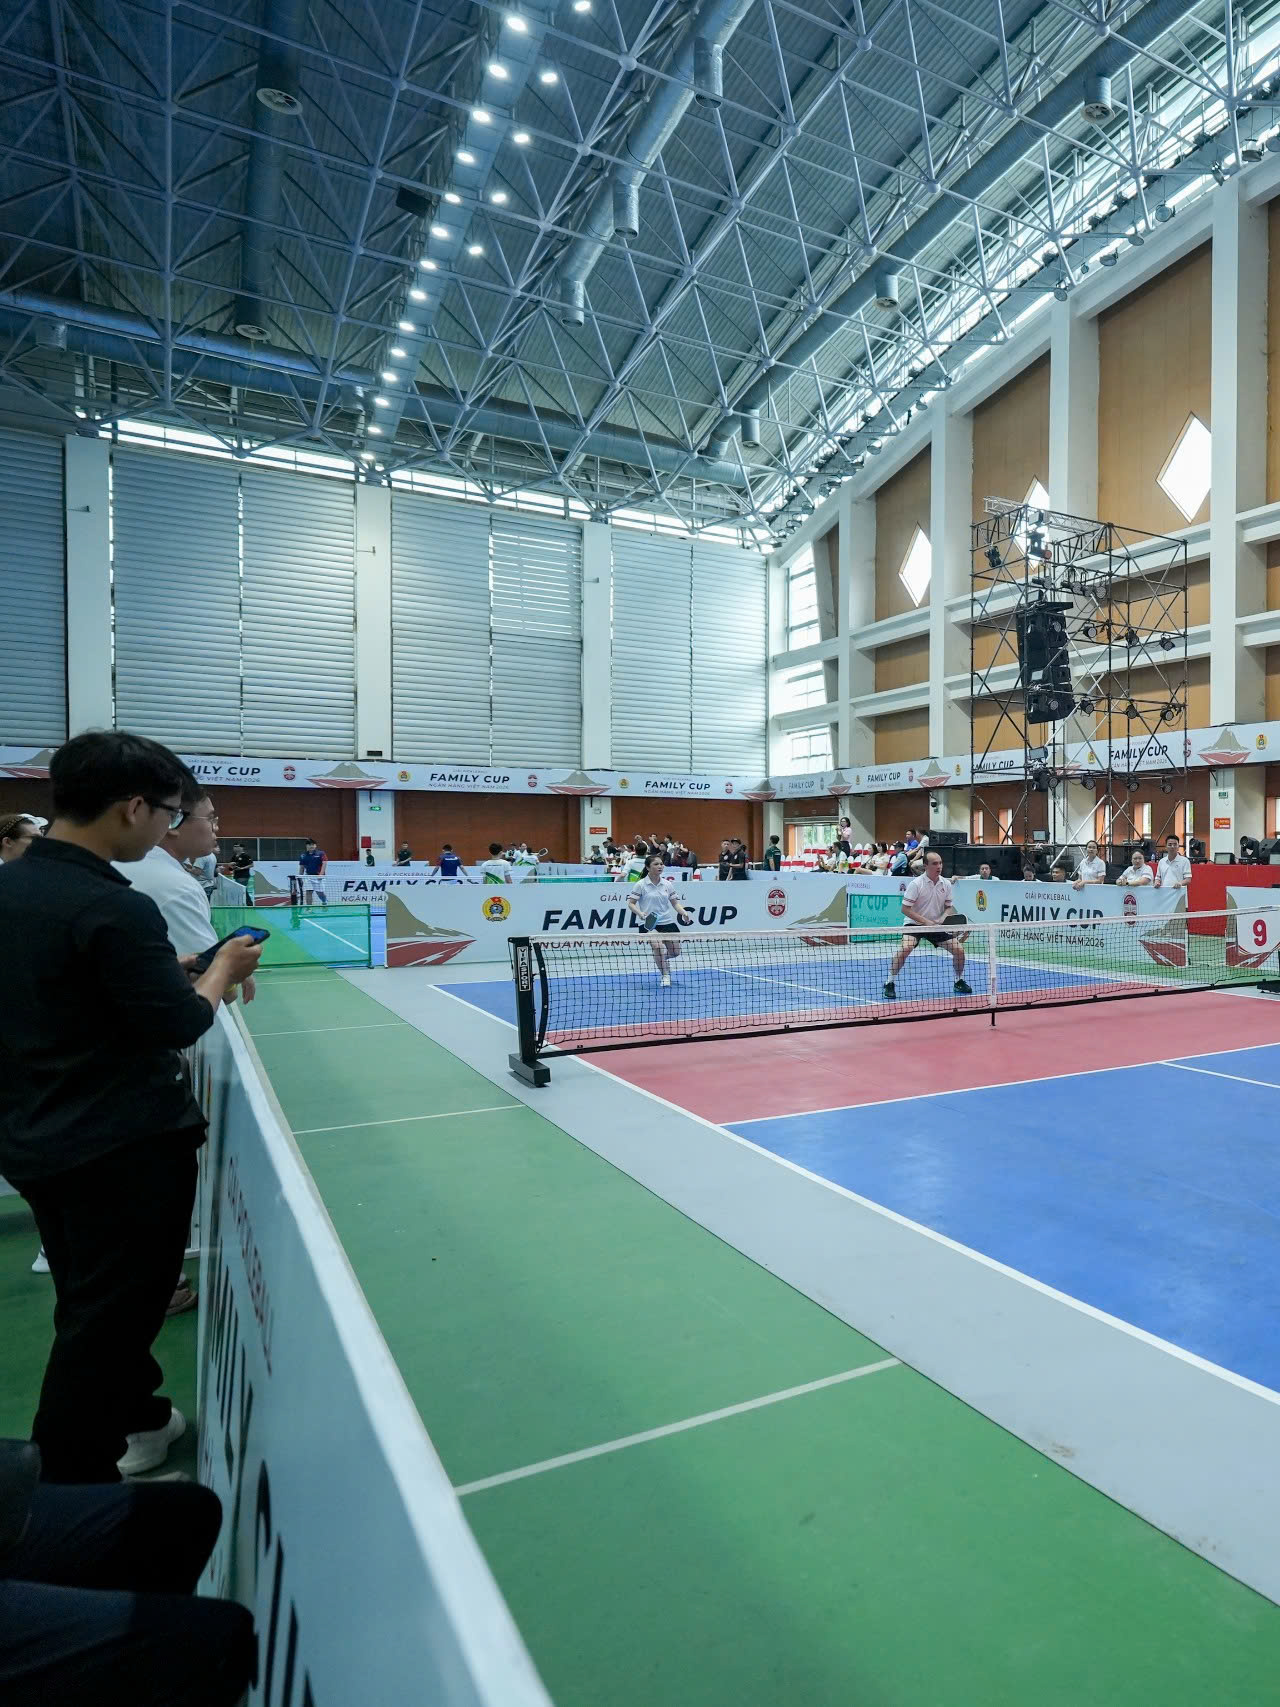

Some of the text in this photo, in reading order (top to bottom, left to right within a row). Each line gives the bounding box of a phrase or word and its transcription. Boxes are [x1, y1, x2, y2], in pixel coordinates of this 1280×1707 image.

[1147, 745, 1168, 757] CUP
[190, 766, 261, 776] MILY CUP
[867, 771, 901, 782] FAMILY CUP
[430, 773, 510, 784] FAMILY CUP
[645, 781, 711, 790] FAMILY CUP
[1038, 893, 1071, 901] PICKLEBALL
[542, 906, 738, 931] FAMIL CUP
[1001, 904, 1104, 930] FAMILY CUP
[1252, 919, 1267, 947] 9
